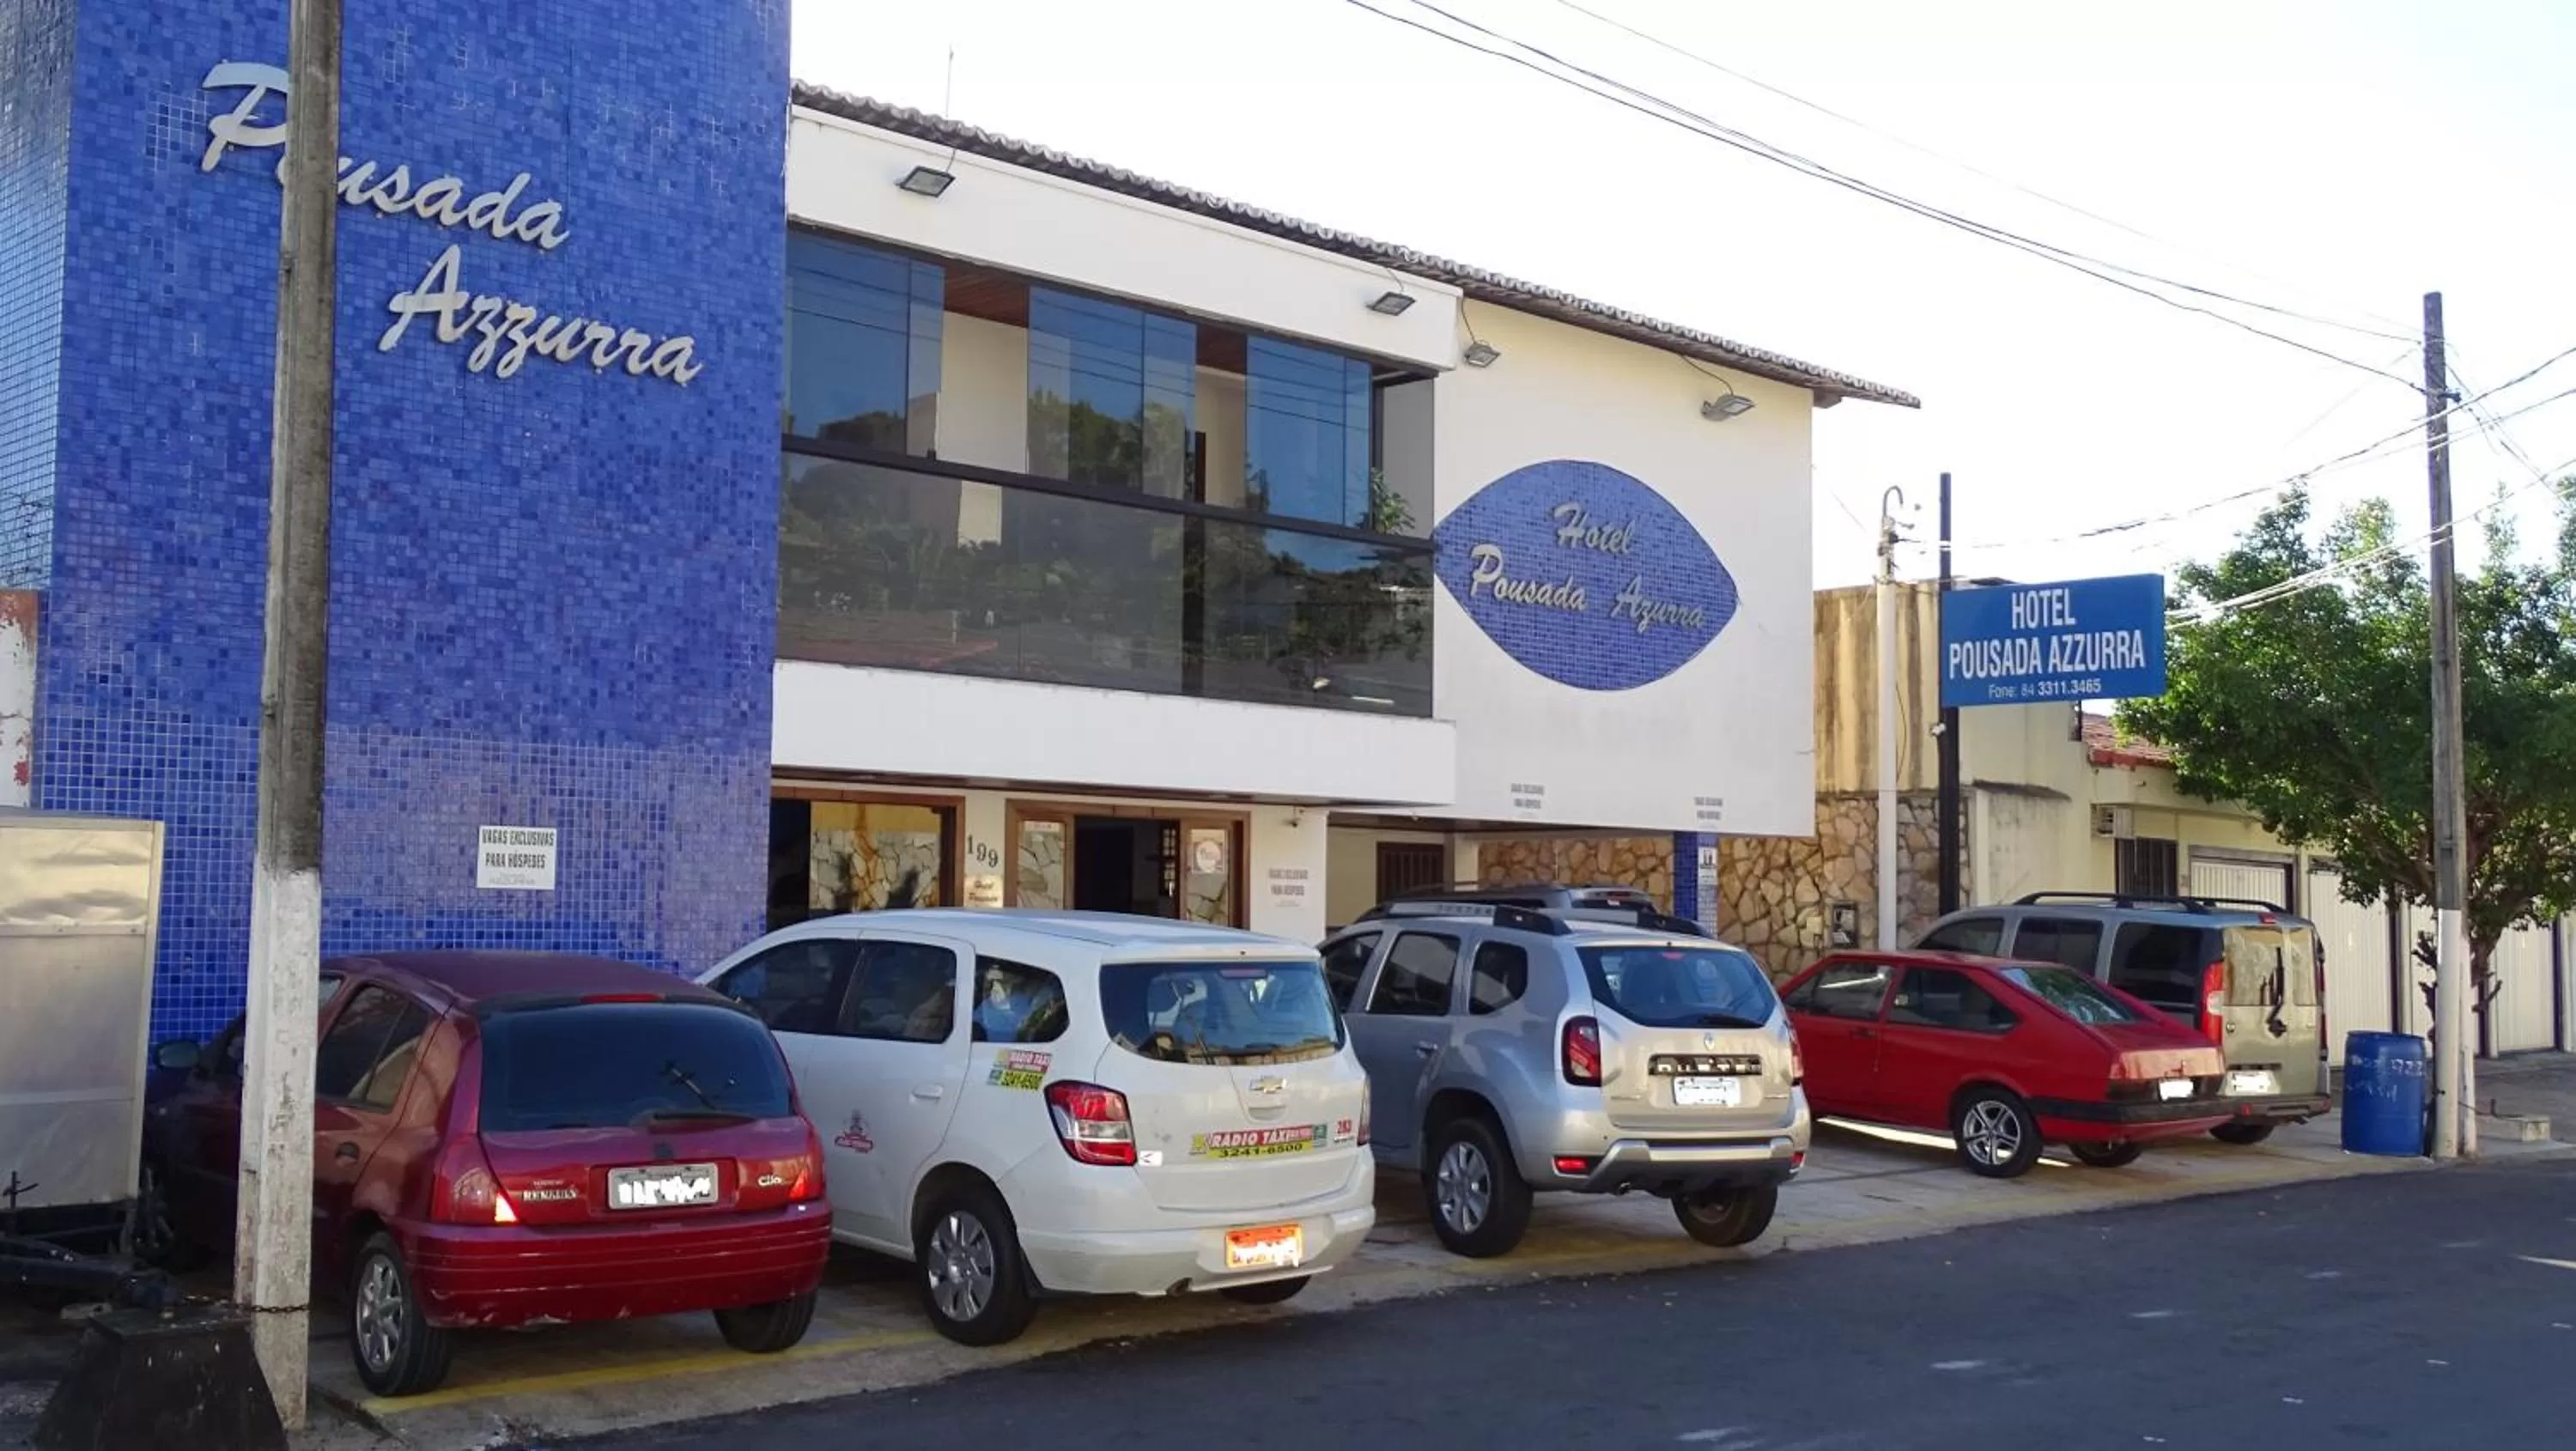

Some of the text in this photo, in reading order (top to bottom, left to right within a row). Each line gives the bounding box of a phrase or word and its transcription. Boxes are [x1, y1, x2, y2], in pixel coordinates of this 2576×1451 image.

[203, 62, 570, 251] Pusada
[379, 244, 704, 385] Azzurra
[1552, 501, 1636, 555] Hotel
[1470, 543, 1588, 612] Pousada
[2012, 588, 2076, 630] HOTEL
[1948, 629, 2146, 680] POUSADA AZZURRA
[482, 829, 555, 847] VAGAS EXCLUSIVAS
[485, 852, 506, 868] PARA
[967, 834, 999, 869] 199
